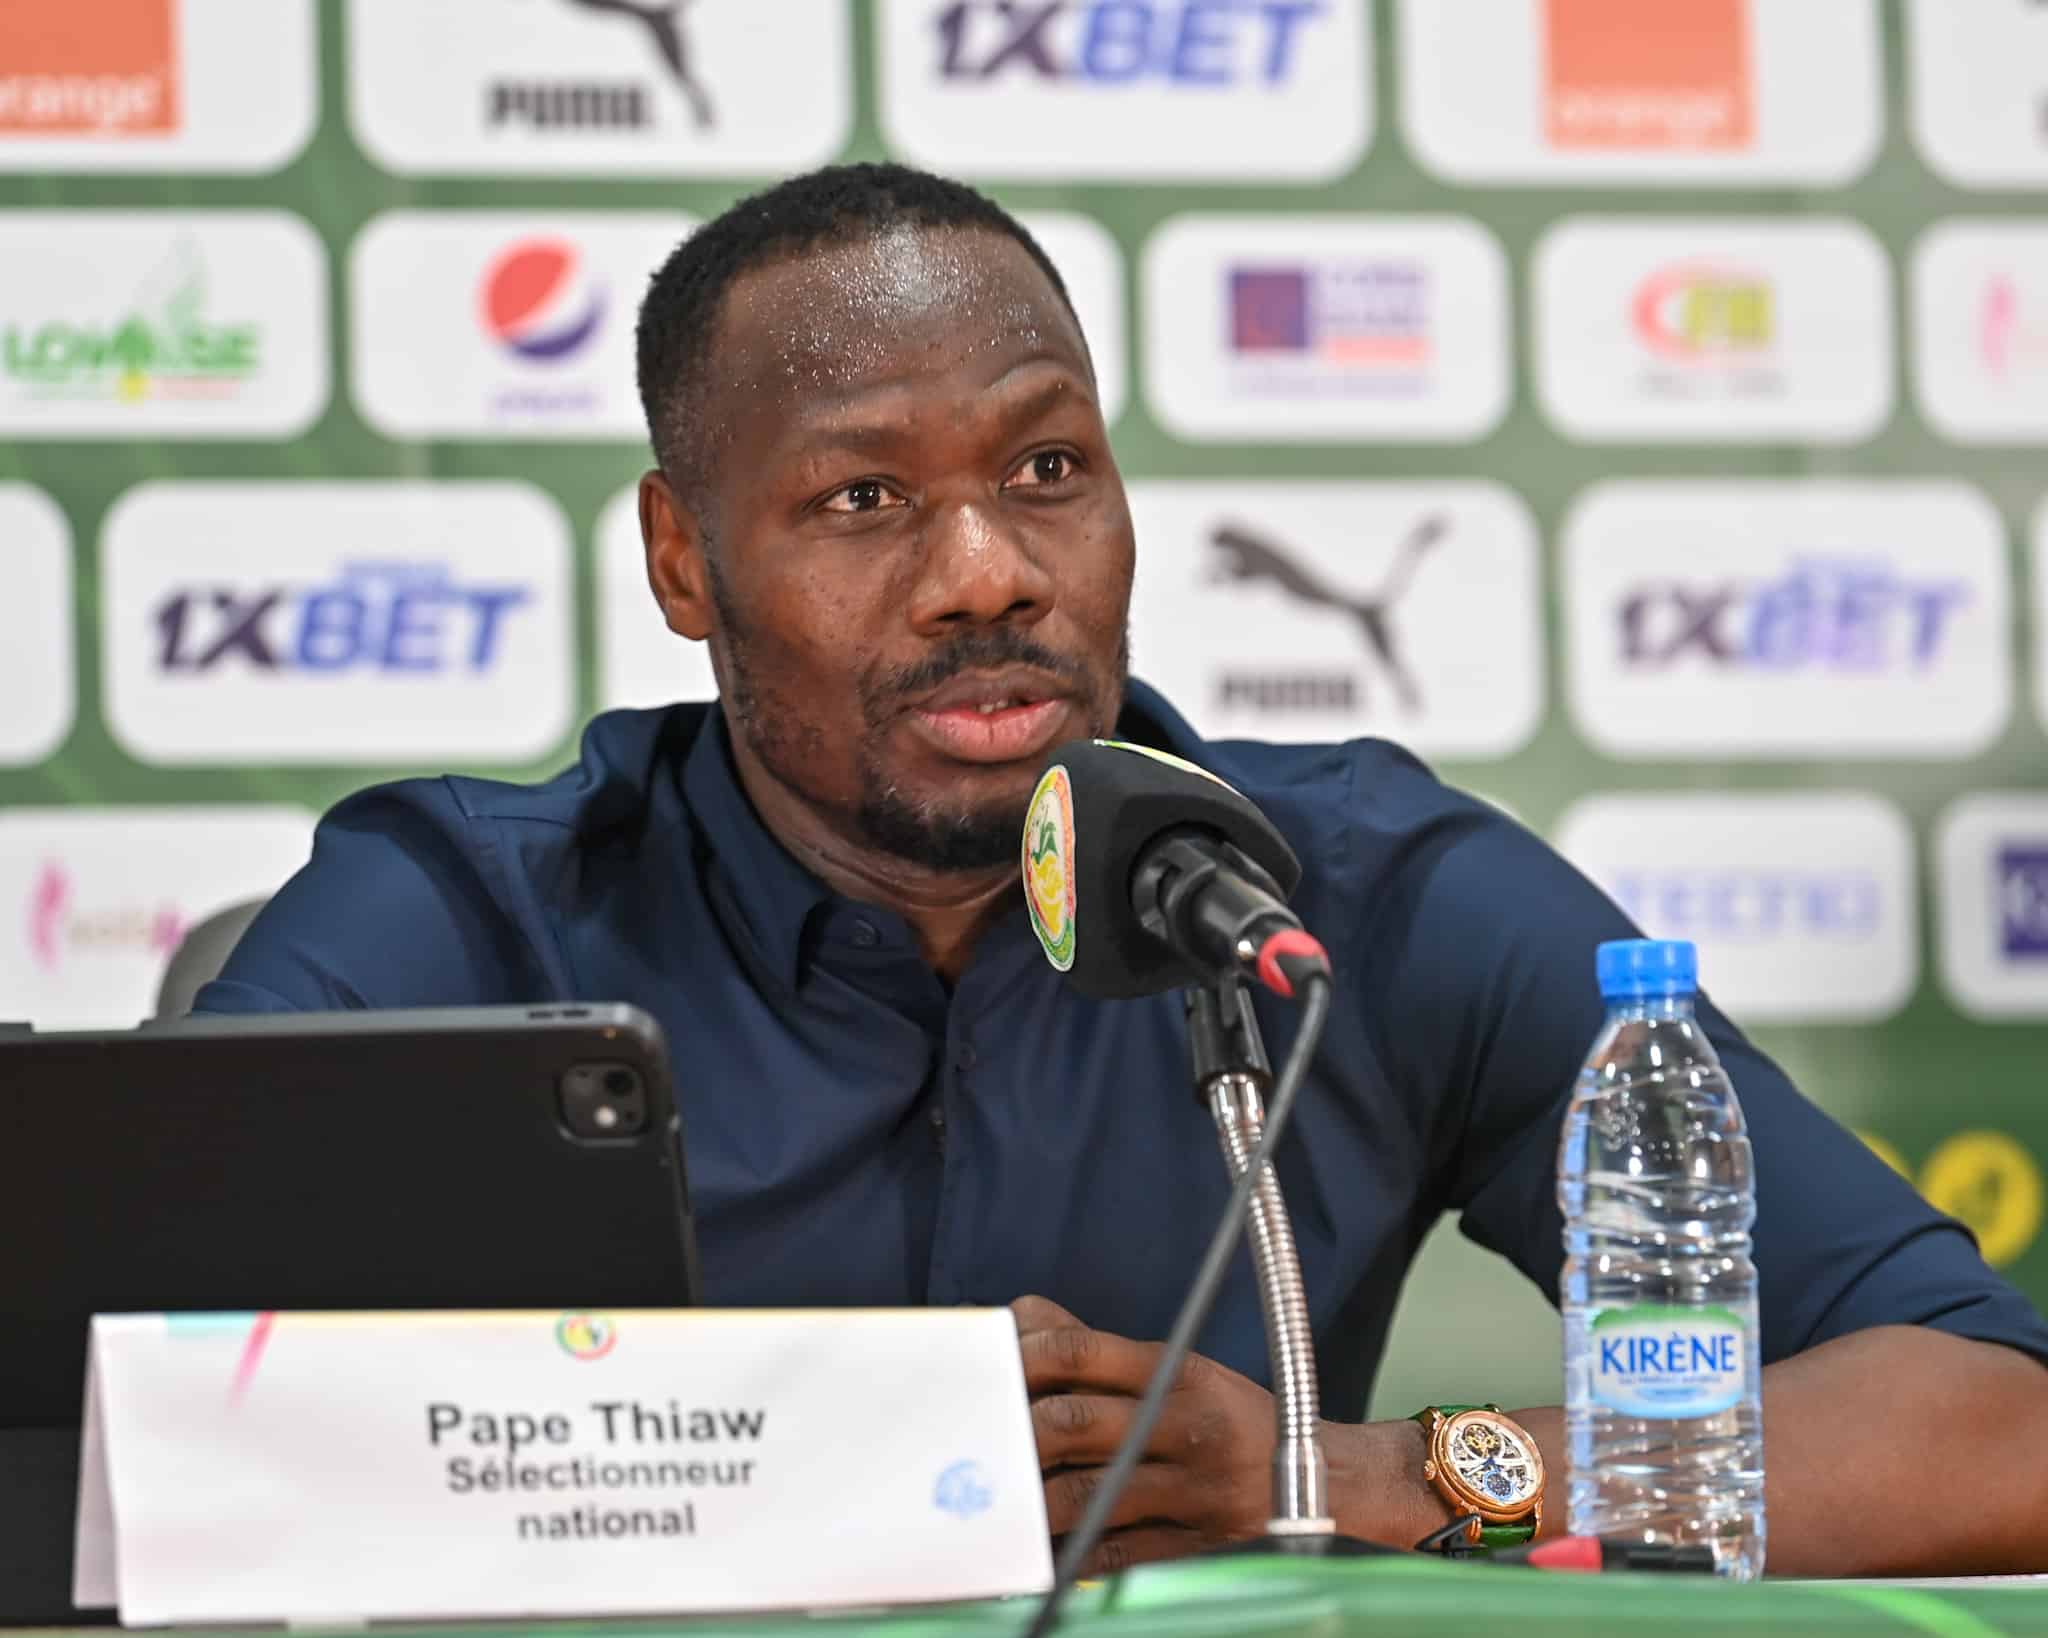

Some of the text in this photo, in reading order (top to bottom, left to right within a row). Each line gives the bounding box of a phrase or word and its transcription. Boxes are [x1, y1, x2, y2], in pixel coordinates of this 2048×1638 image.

[932, 0, 1327, 86] 1XBET
[0, 75, 158, 130] range
[155, 583, 531, 676] 1XBET
[1616, 578, 1970, 672] 1XBET
[1601, 1331, 1736, 1374] KIRÈNE
[427, 1399, 765, 1452] Pape Thiaw
[448, 1455, 754, 1492] Sélectionneur
[517, 1500, 696, 1539] national
